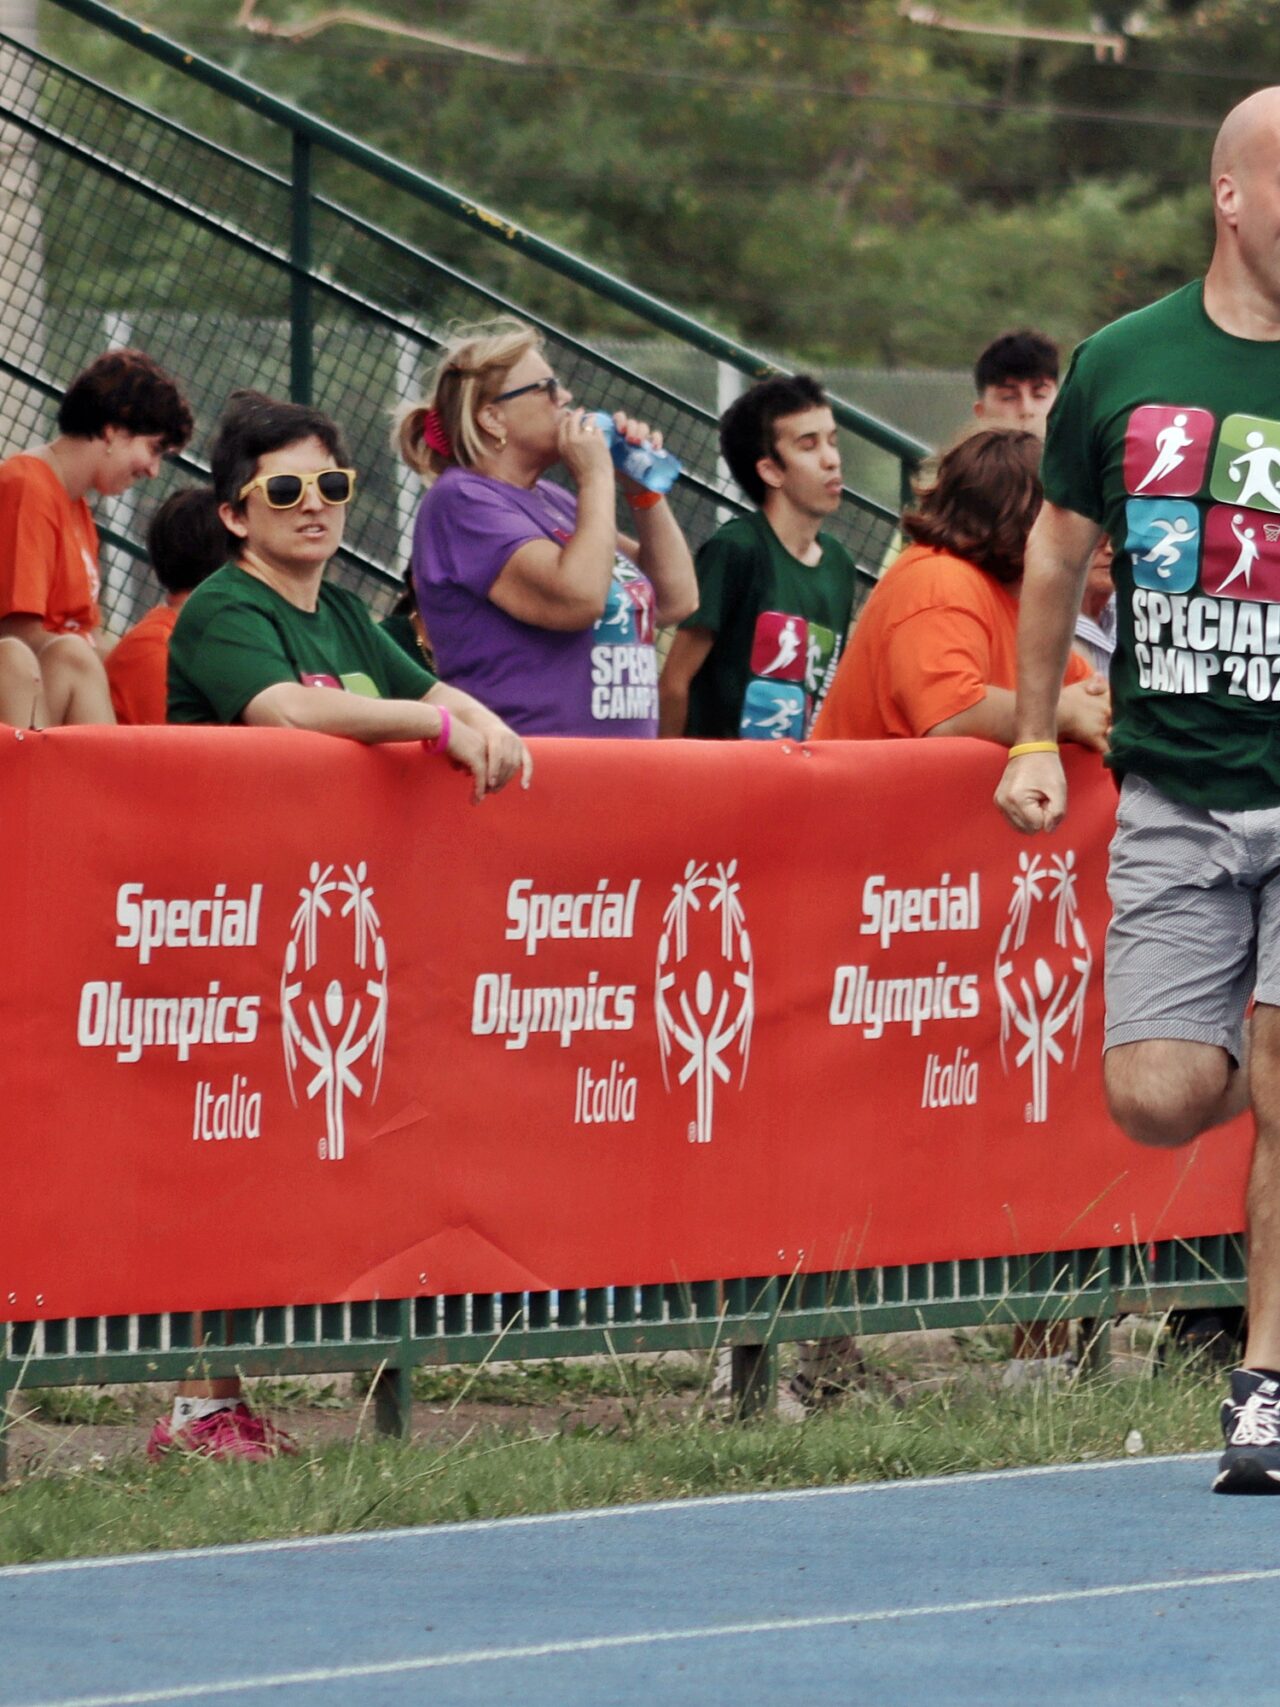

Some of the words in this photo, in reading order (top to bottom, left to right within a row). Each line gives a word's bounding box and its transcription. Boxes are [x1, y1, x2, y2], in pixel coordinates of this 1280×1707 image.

[590, 646, 657, 686] SPEC
[1135, 643, 1221, 694] CAMP
[116, 883, 263, 964] Special
[505, 879, 641, 955] Special
[860, 871, 981, 949] Special
[77, 981, 261, 1063] Olympics
[471, 971, 636, 1050] Olympics
[829, 961, 981, 1039] Olympics
[193, 1074, 262, 1141] Italia
[574, 1060, 637, 1124] Italia
[921, 1046, 979, 1108] Italia
